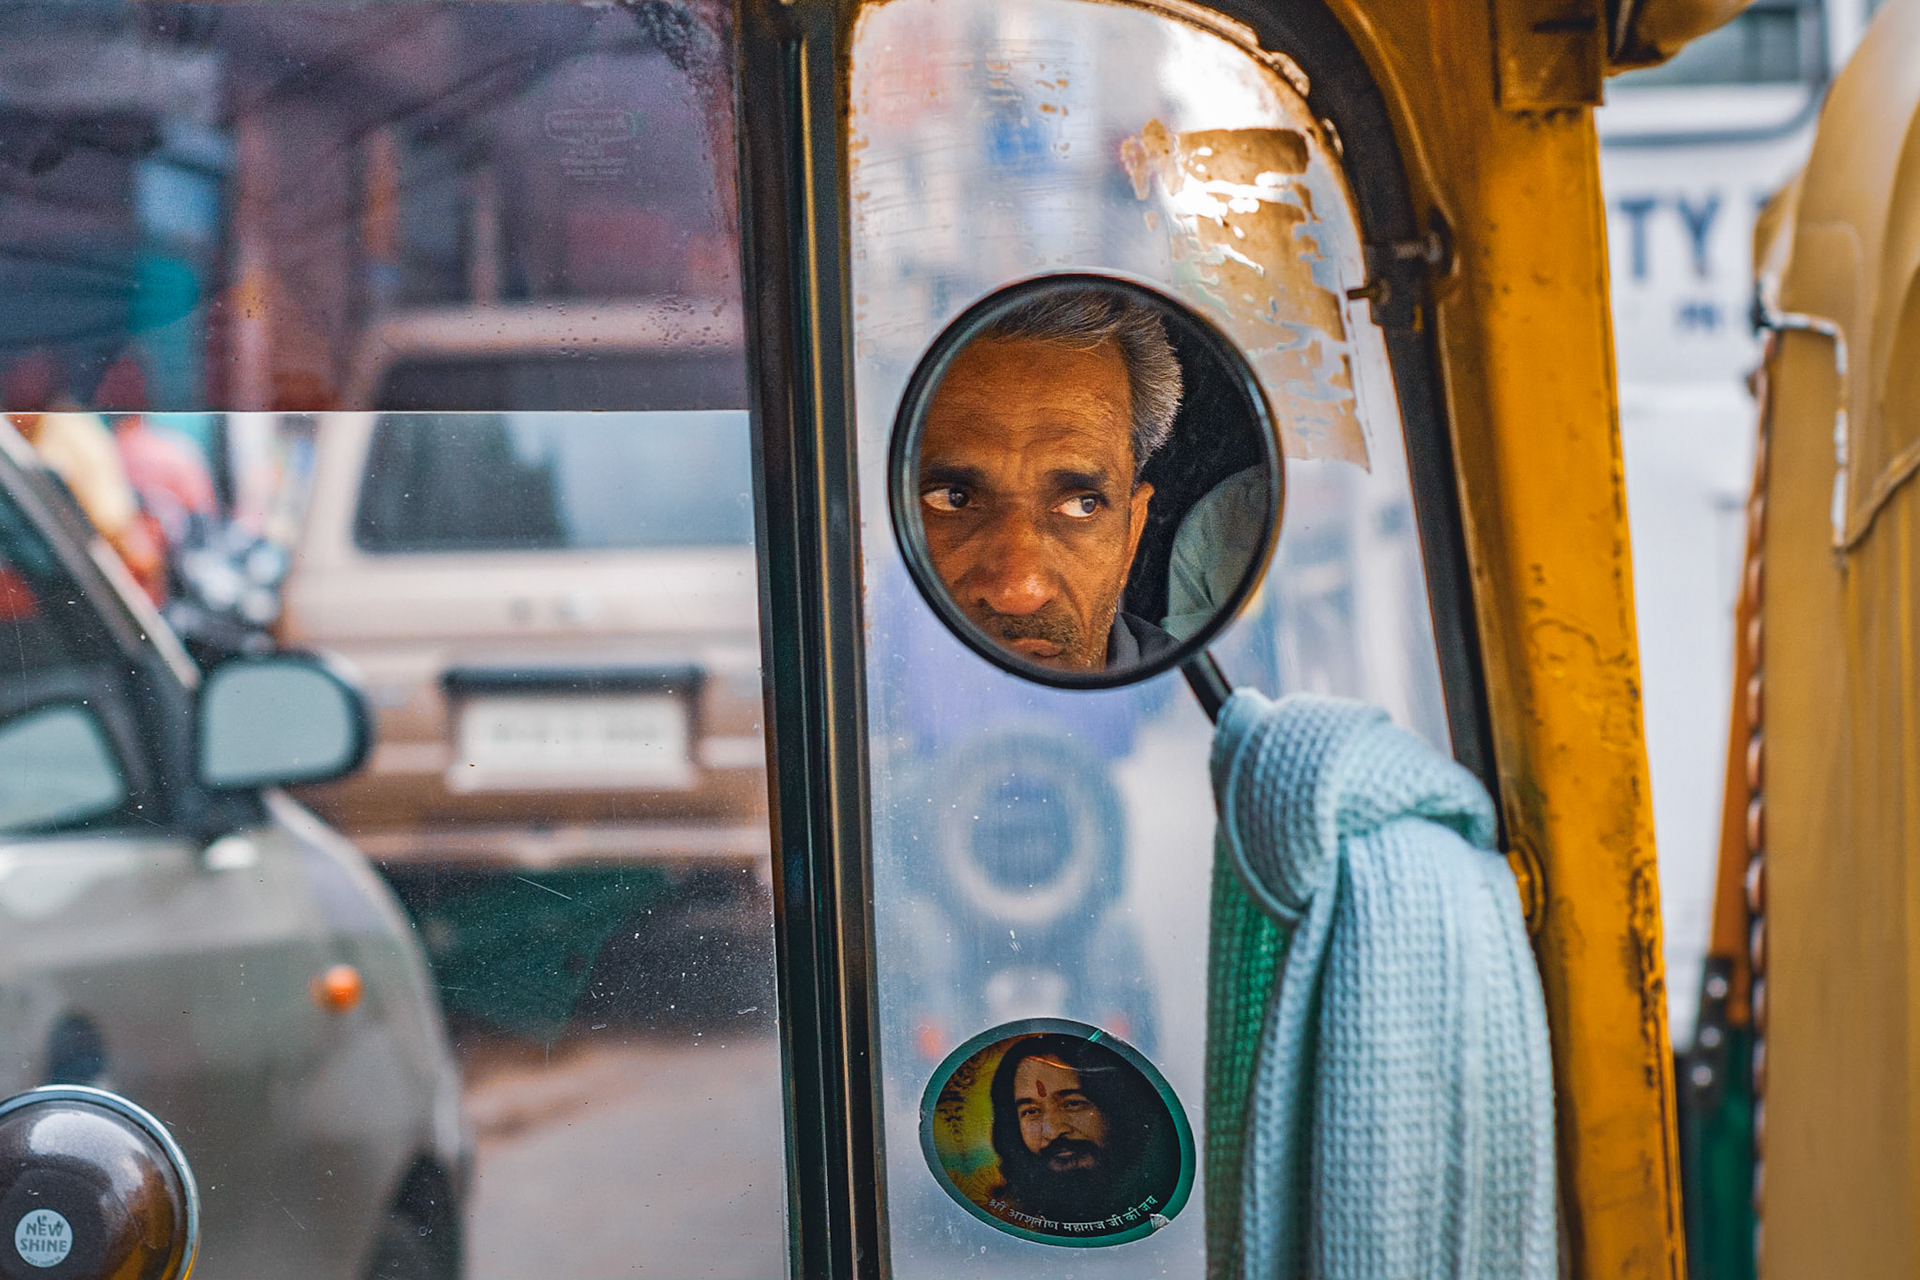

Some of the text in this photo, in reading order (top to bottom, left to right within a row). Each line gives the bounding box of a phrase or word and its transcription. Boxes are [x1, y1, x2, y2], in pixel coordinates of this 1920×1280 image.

[989, 1198, 1006, 1212] श्री
[1062, 1220, 1105, 1232] महाराज
[1105, 1213, 1124, 1226] जी
[1122, 1206, 1141, 1221] की
[1138, 1195, 1158, 1211] जय
[26, 1222, 64, 1236] NEW
[20, 1238, 67, 1252] SHINE
